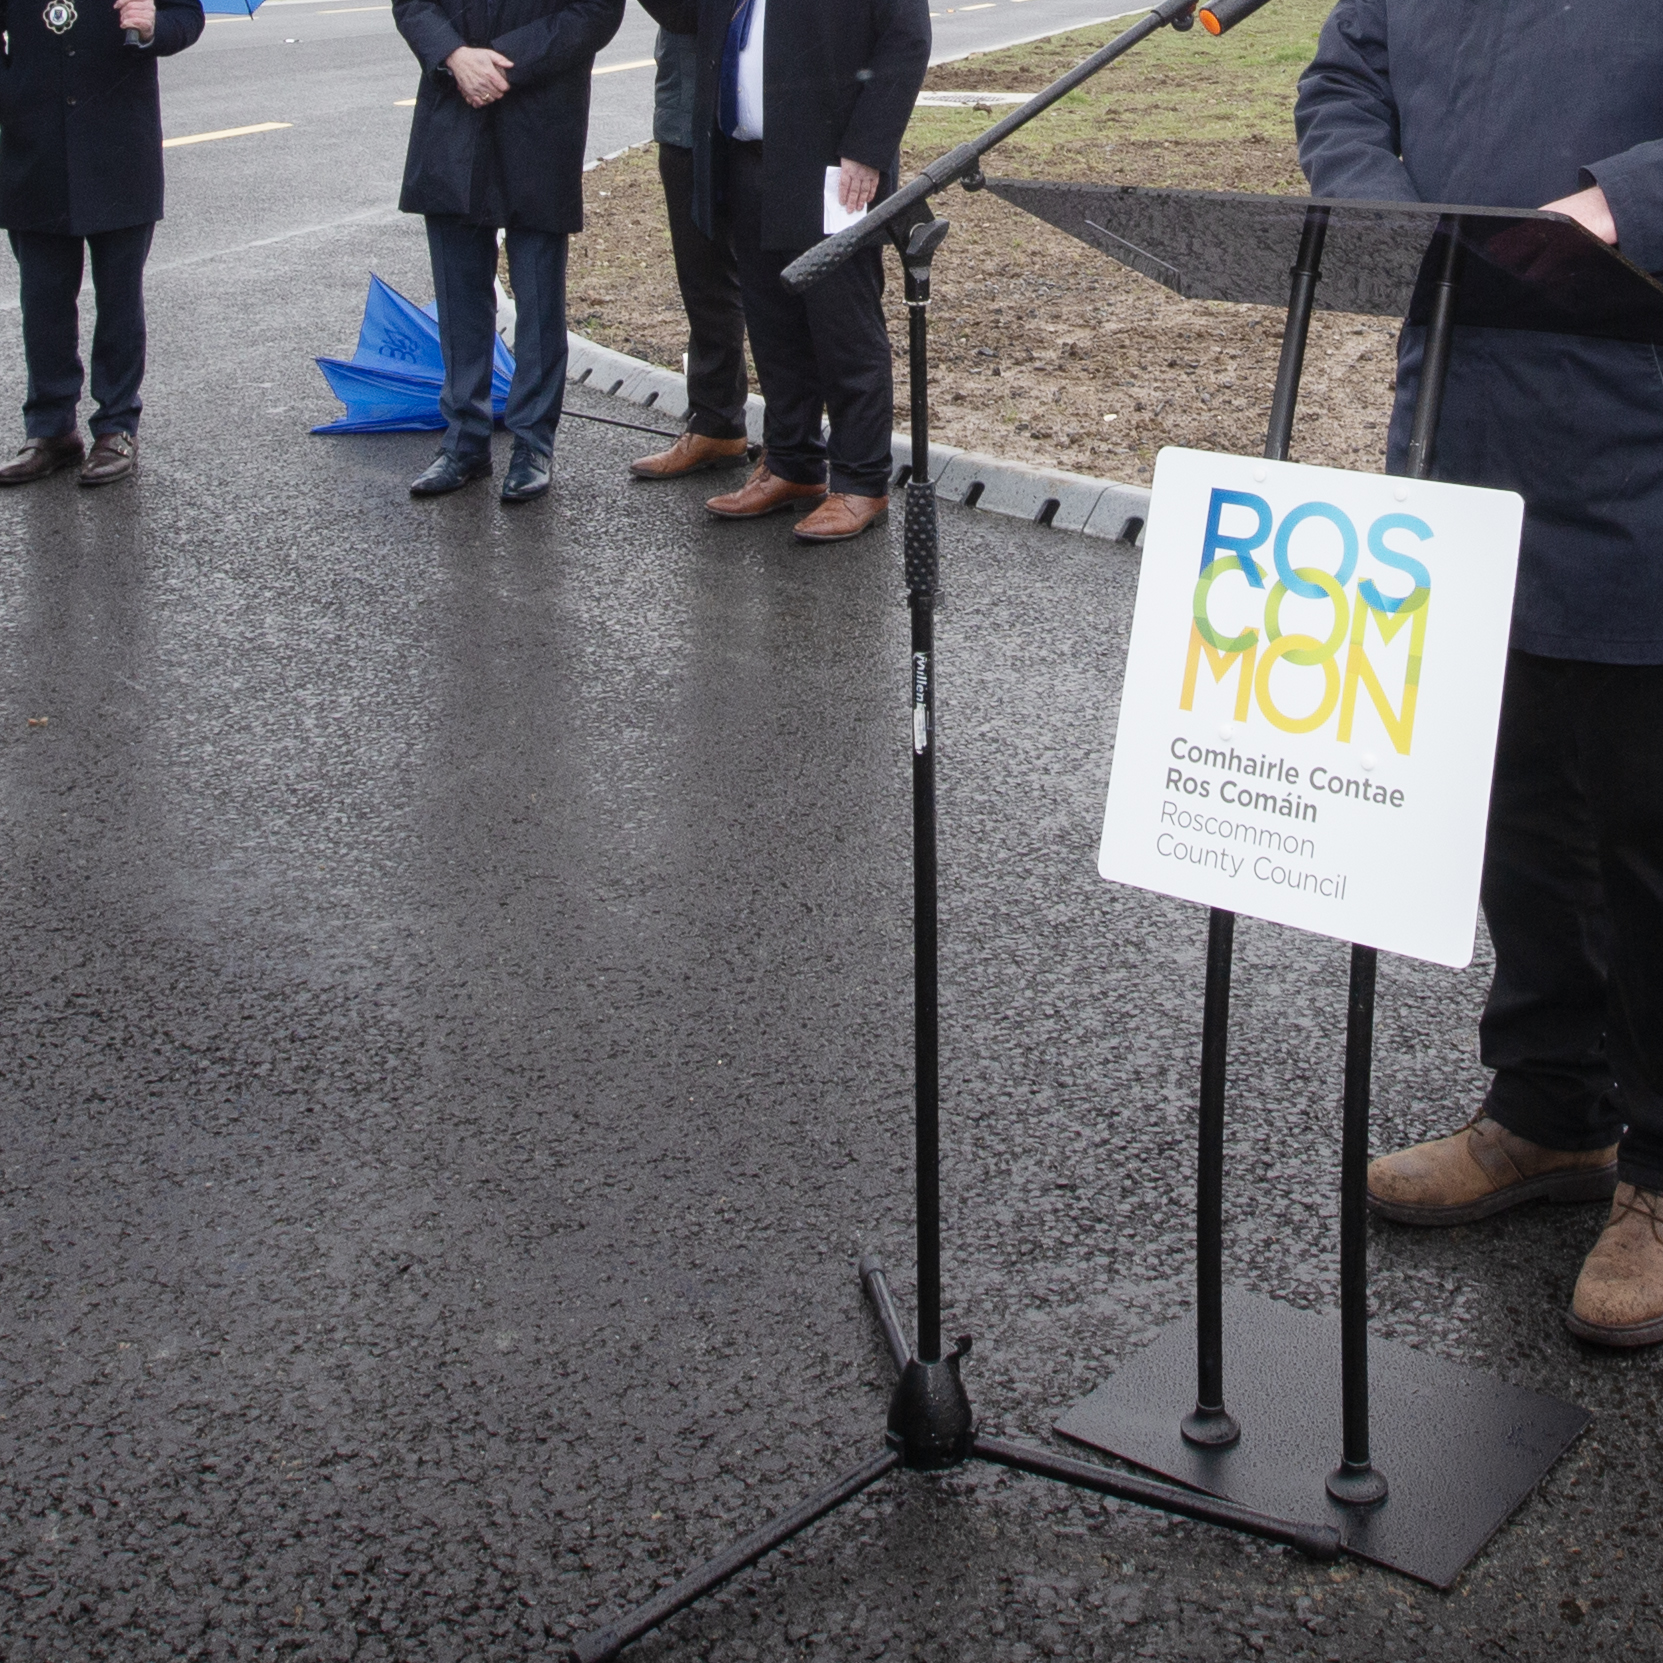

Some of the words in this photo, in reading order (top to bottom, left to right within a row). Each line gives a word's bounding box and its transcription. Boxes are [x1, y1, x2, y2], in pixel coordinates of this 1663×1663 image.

[1199, 487, 1434, 614] ROS
[1193, 555, 1432, 685] COM
[1178, 617, 1419, 756] MON
[1165, 767, 1211, 799] Ros
[1219, 781, 1318, 824] Comáin
[1170, 737, 1300, 786] Comhairle
[1308, 766, 1405, 809] Contae
[1160, 801, 1315, 859] Roscommon
[1156, 833, 1245, 879] County
[1253, 856, 1347, 901] Council
